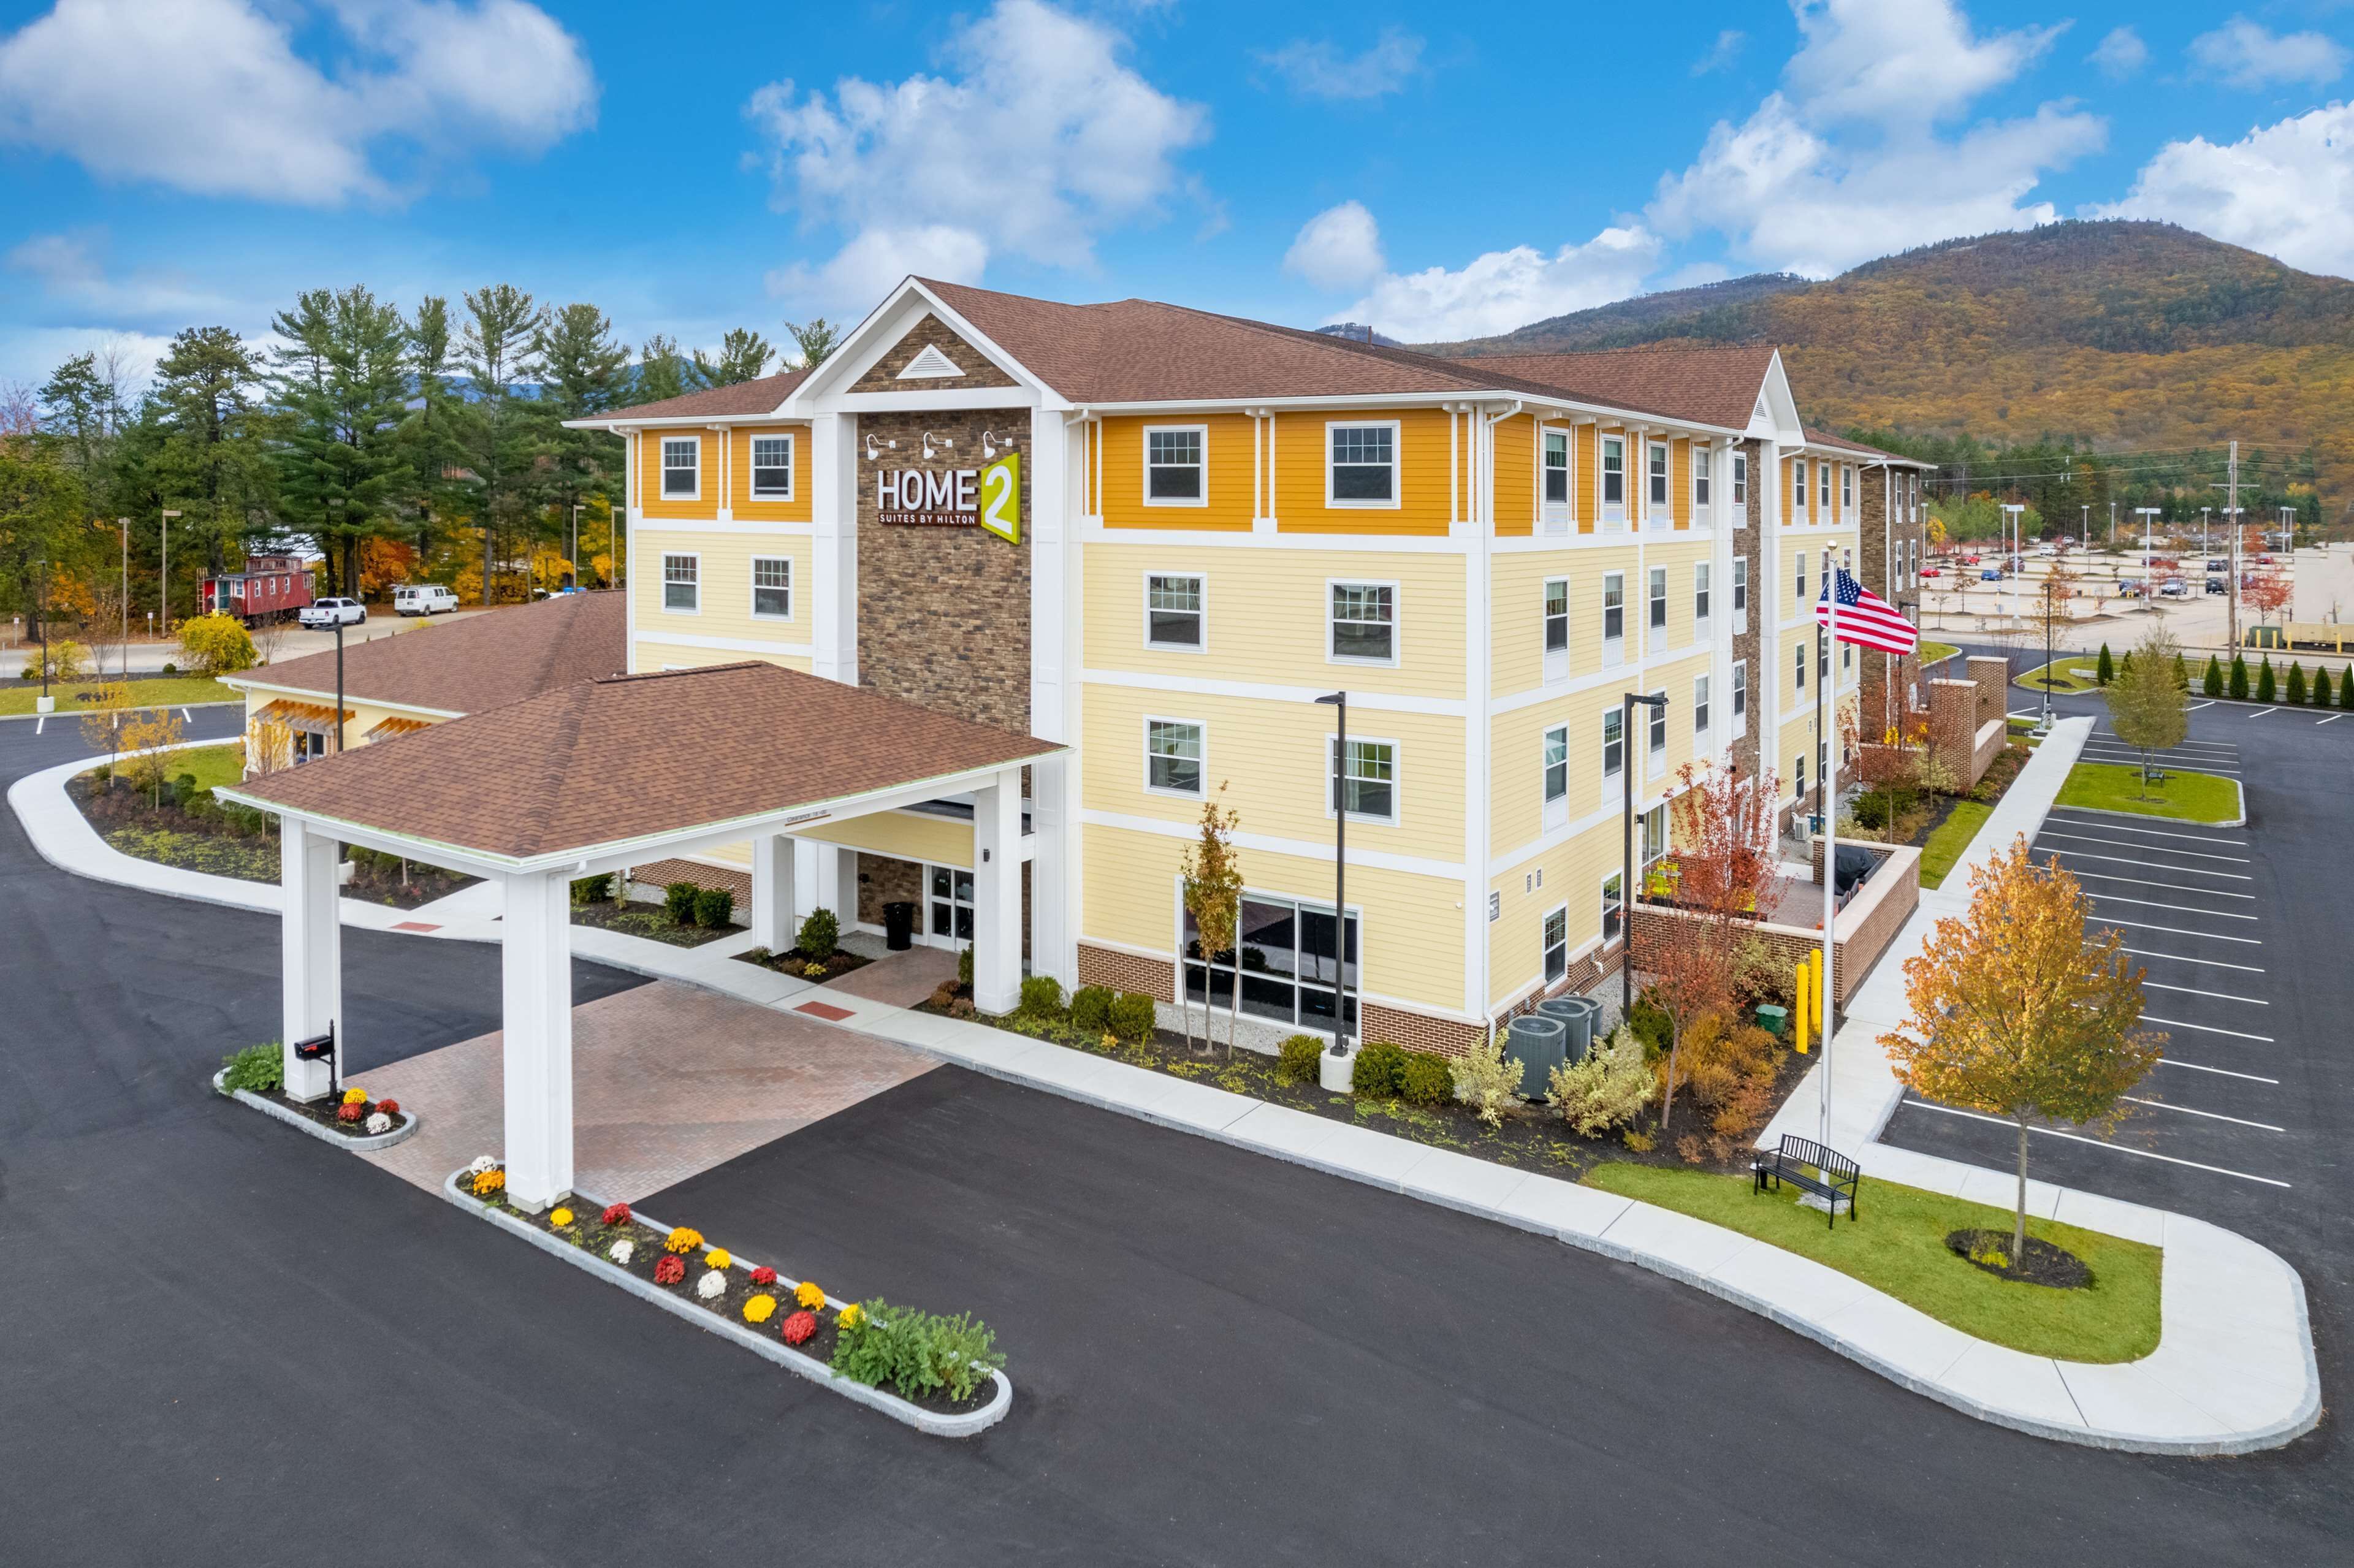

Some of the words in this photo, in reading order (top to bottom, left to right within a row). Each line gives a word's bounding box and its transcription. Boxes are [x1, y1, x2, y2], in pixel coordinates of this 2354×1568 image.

[878, 470, 978, 511] HOME
[985, 465, 1013, 535] 2
[880, 514, 916, 523] SUITES
[920, 514, 933, 523] BY
[937, 515, 975, 524] HILTON
